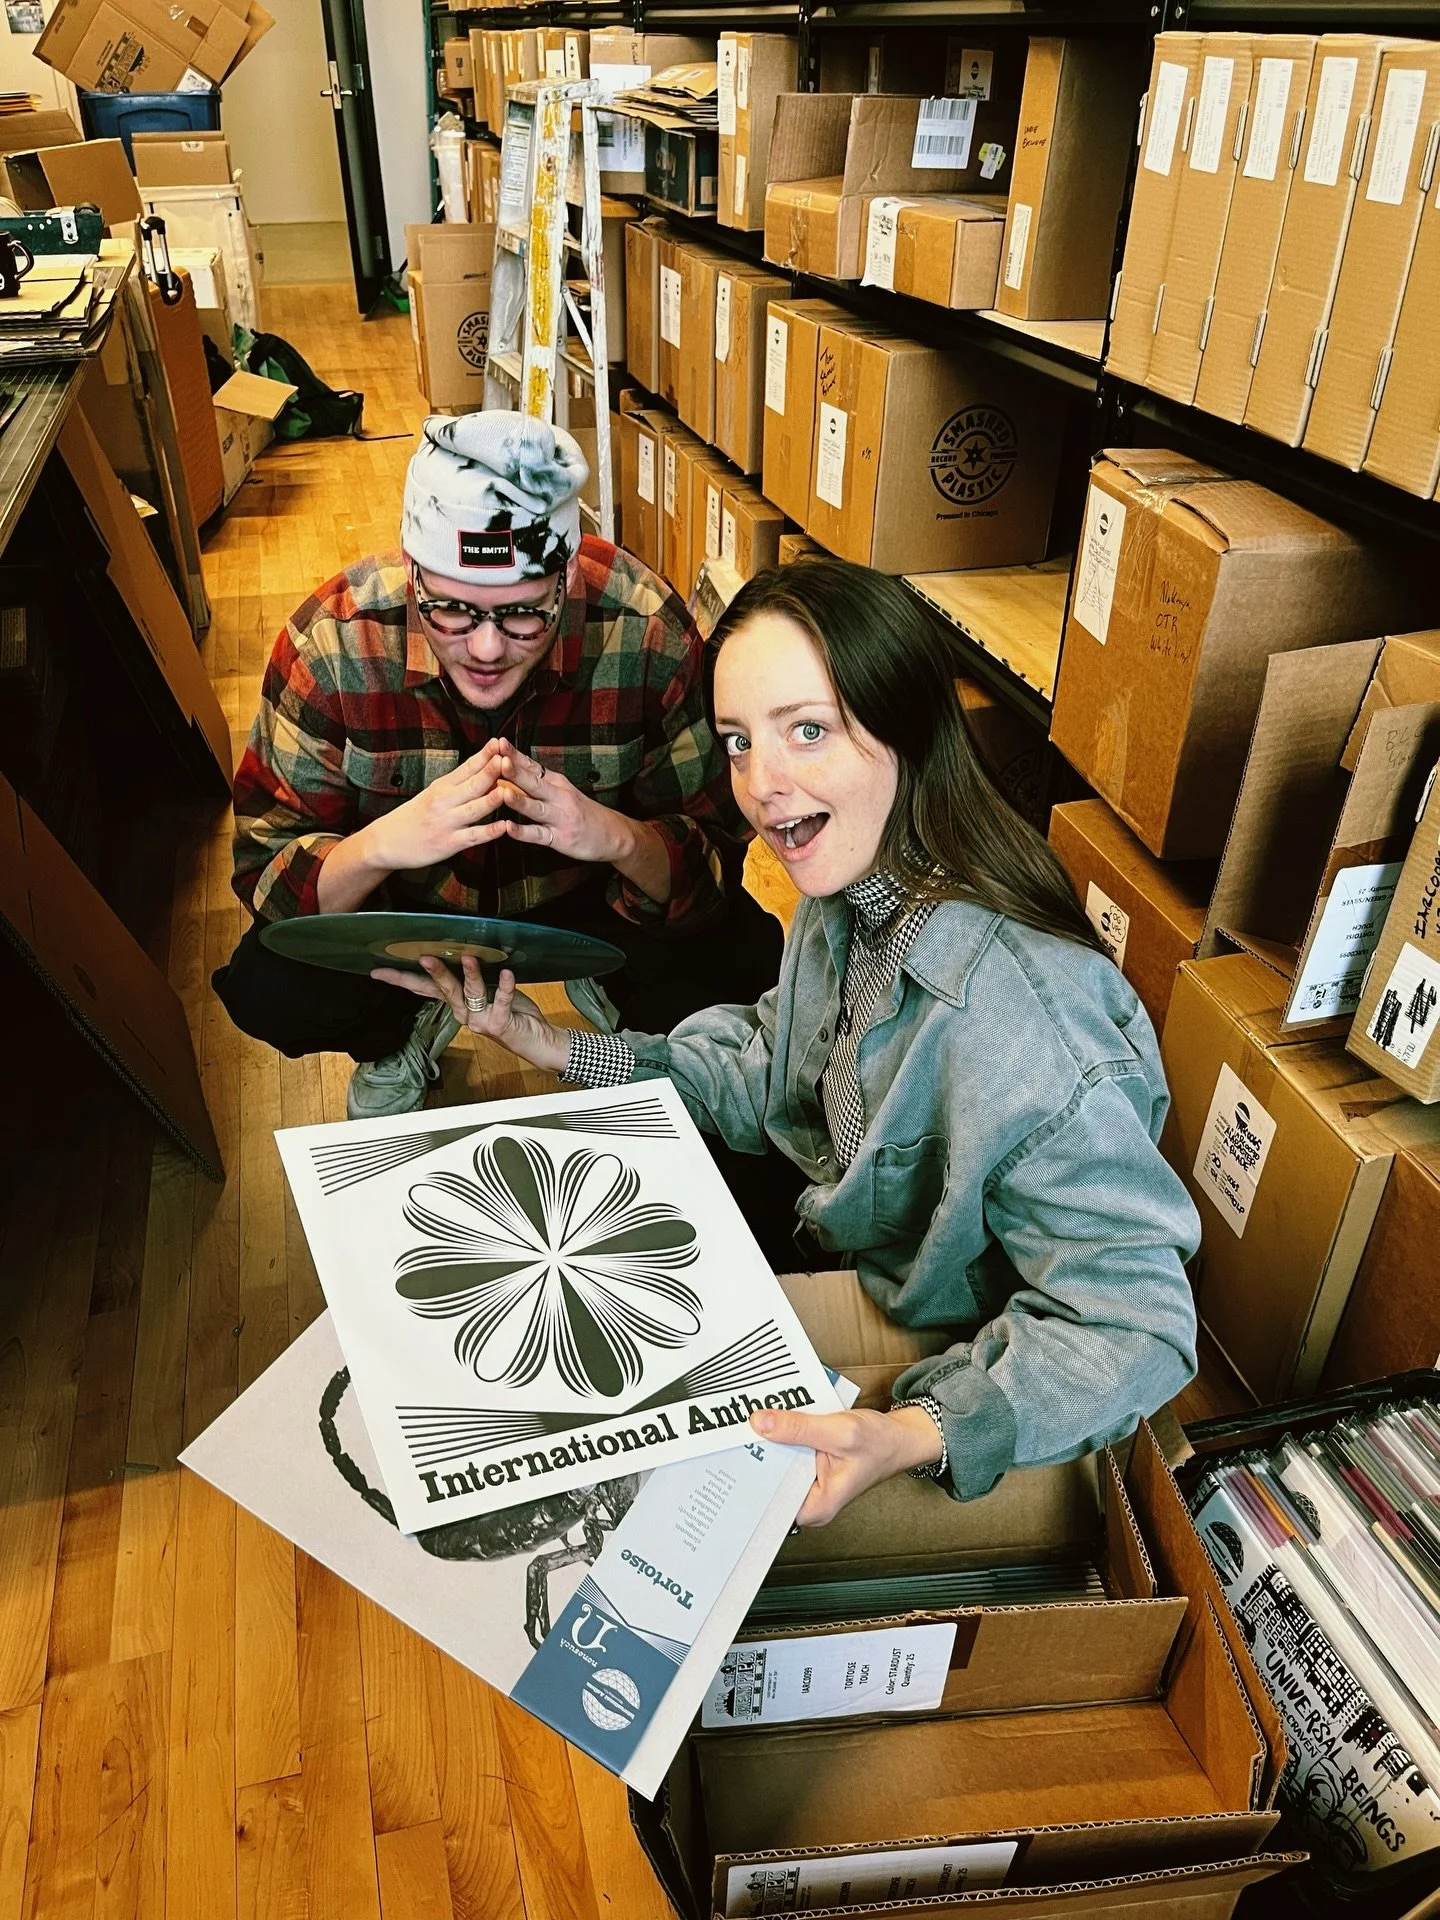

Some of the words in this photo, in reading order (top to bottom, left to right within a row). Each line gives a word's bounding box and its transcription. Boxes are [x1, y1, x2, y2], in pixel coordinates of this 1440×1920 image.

[941, 469, 1002, 498] PLASTIC
[462, 546, 480, 554] THE
[481, 546, 508, 554] SMITH
[1155, 613, 1178, 633] OTR
[1341, 894, 1387, 906] GREEN/SILVER
[1344, 930, 1376, 940] TORTOISE
[1352, 922, 1374, 931] TOUCH
[419, 1412, 678, 1504] International
[688, 1385, 815, 1435] Anthem
[620, 1548, 694, 1610] Tortoise
[560, 1637, 598, 1668] nonesuch
[888, 1647, 902, 1678] STARDUST
[905, 1653, 915, 1661] 25
[801, 1667, 813, 1694] IARC0099
[844, 1661, 857, 1690] TORTOISE
[859, 1664, 870, 1685] TOUCH
[885, 1678, 897, 1695] Color:
[901, 1662, 915, 1687] Quantity:
[1265, 1650, 1344, 1760] UNIVERSAL
[1277, 1700, 1322, 1758] McCRAVEN
[1343, 1765, 1406, 1852] BEINGS
